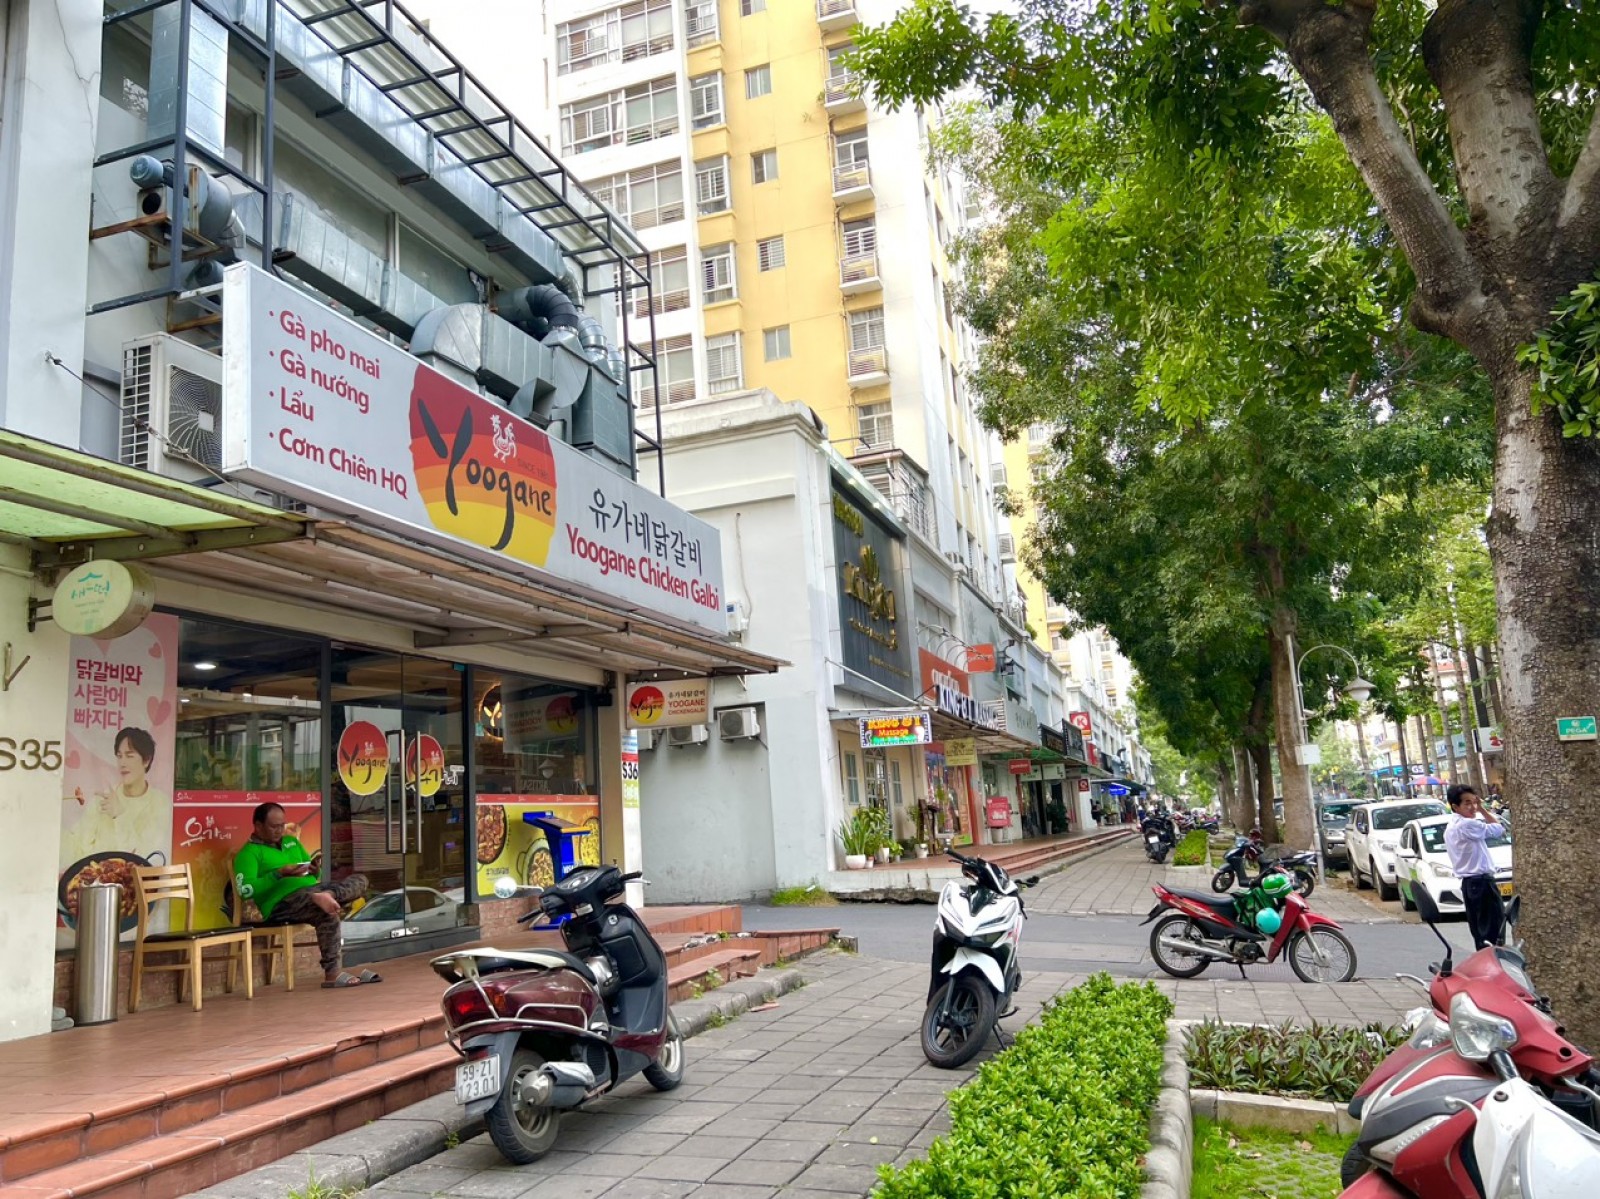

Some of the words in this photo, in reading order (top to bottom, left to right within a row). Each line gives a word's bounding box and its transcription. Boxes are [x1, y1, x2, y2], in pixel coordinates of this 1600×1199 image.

[280, 311, 306, 341] Gà
[310, 329, 346, 360] pho
[350, 351, 380, 379] mai
[280, 349, 306, 379] Gà
[311, 367, 369, 414] nướng
[281, 386, 314, 422] Lẩu
[279, 428, 324, 464] Cơm
[329, 448, 377, 485] Chiên
[381, 467, 408, 500] HQ
[418, 399, 552, 550] Yoogane
[588, 488, 702, 577] 유가네닭갈비
[566, 523, 636, 576] Yoogane
[639, 556, 689, 599] Chicken
[690, 579, 720, 611] Galbi
[75, 658, 143, 686] 닭갈비와
[74, 684, 128, 708] 사랑에
[668, 699, 706, 708] YOOGANE
[73, 707, 125, 731] 빠지다
[867, 718, 899, 730] KING
[878, 728, 909, 737] Massage
[0, 737, 63, 772] S35
[340, 744, 387, 785] Yoogane
[622, 762, 638, 780] S36
